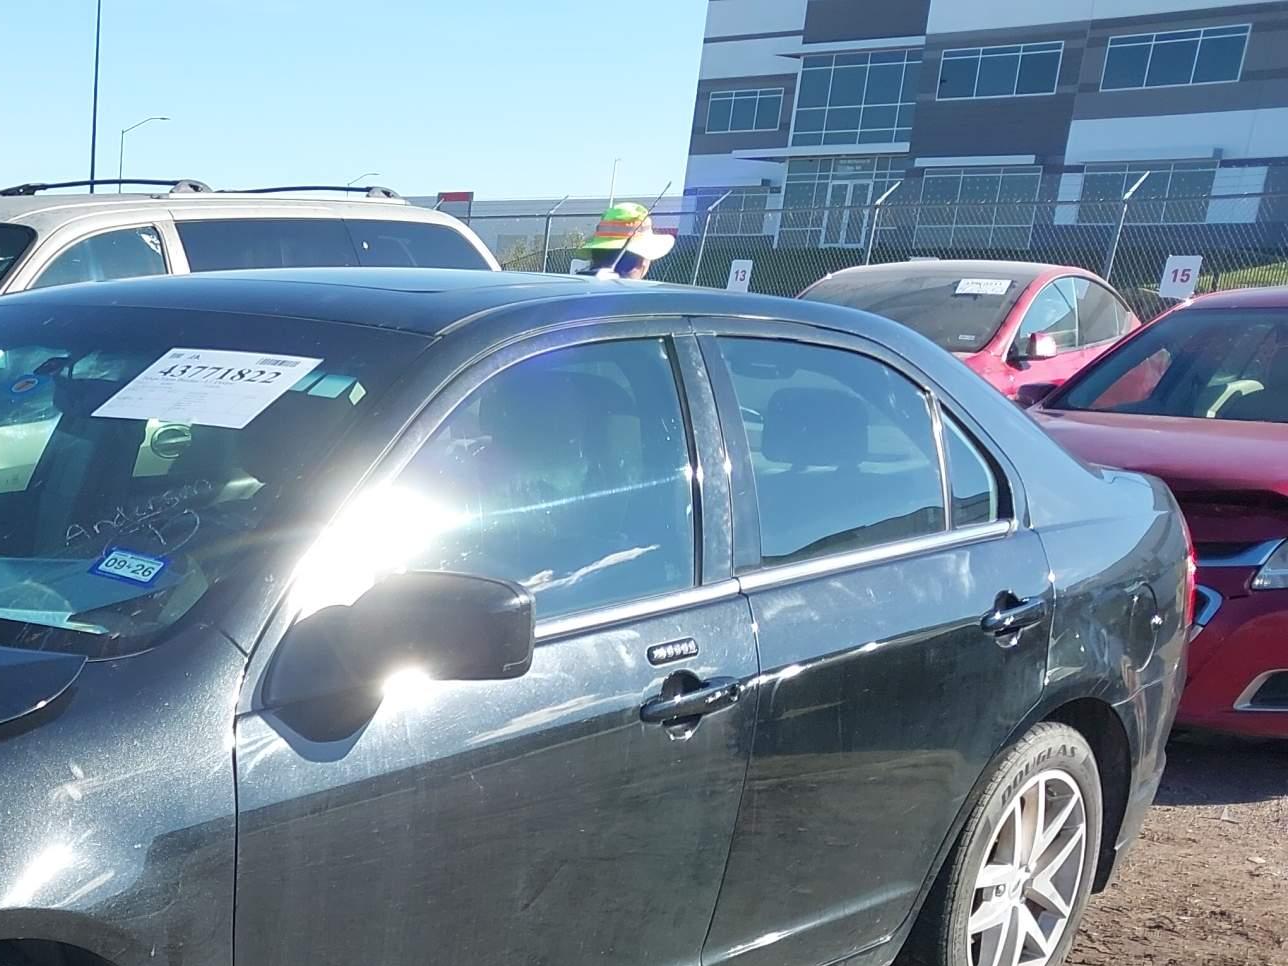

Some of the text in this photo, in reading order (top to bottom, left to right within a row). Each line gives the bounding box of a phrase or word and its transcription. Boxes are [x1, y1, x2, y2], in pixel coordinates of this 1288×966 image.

[735, 270, 746, 281] 13
[1172, 268, 1192, 283] 15
[159, 364, 283, 384] 43771822
[1002, 744, 1078, 808] DOUGLAS
